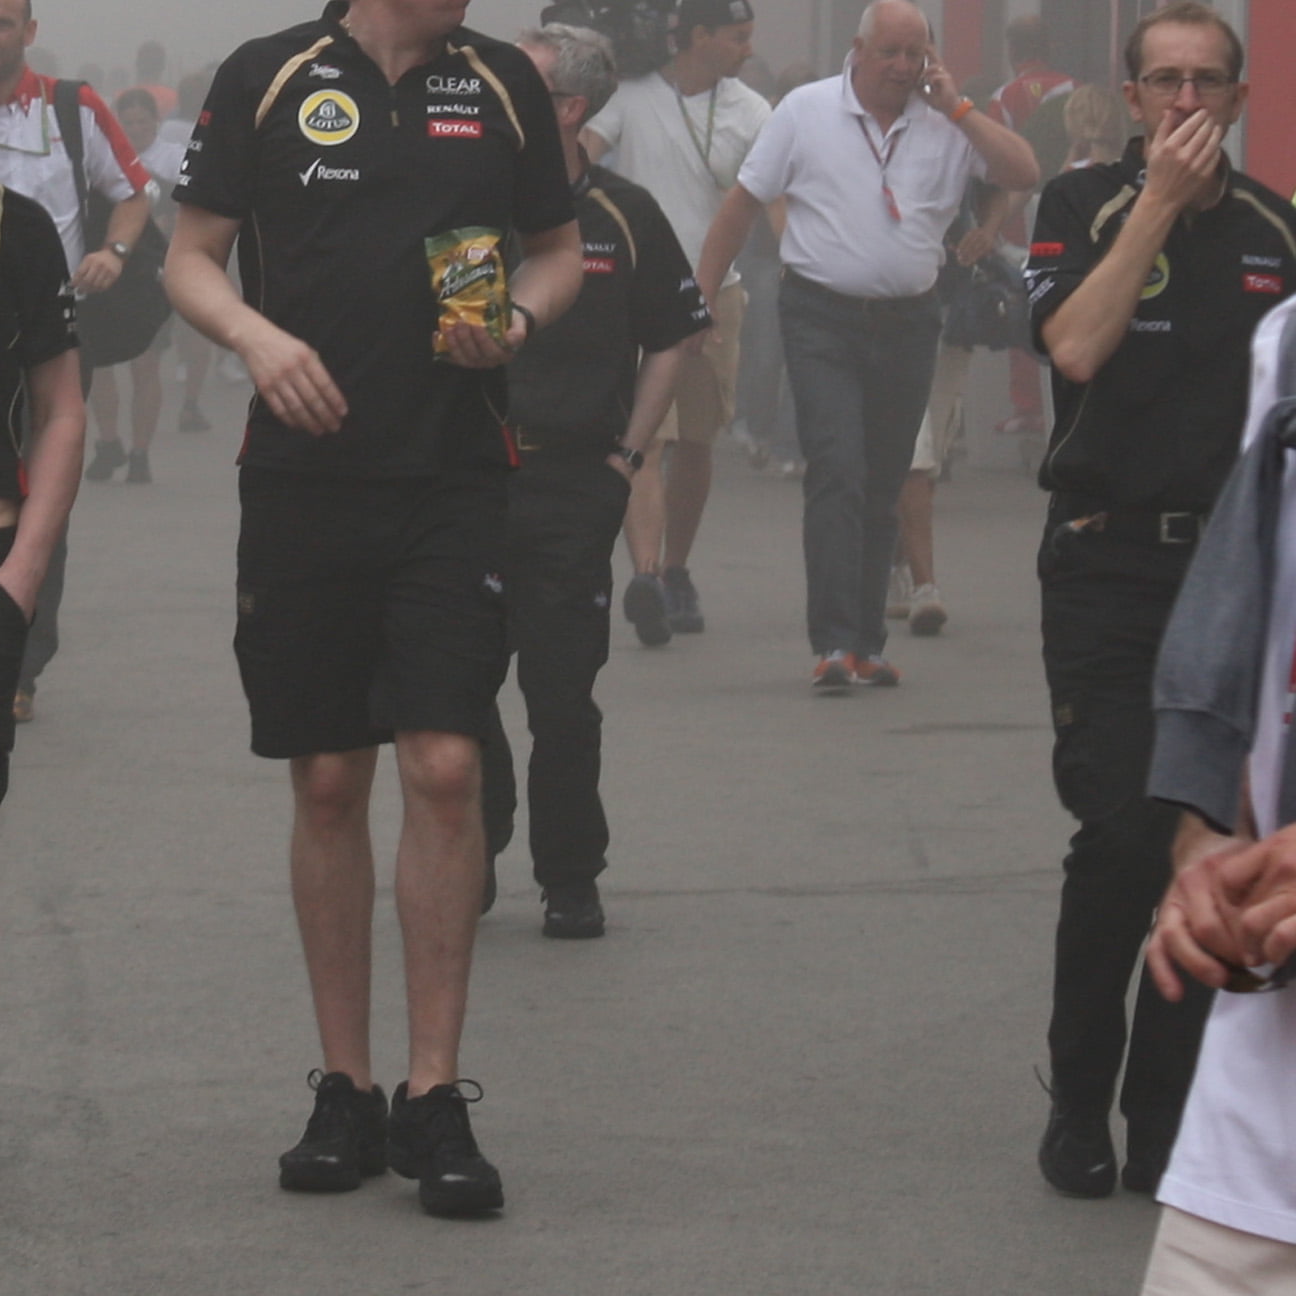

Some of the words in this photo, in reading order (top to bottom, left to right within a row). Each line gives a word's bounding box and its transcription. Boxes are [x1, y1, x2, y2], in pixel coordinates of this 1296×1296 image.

[426, 75, 480, 93] CLEAR
[427, 104, 479, 114] RENAULT
[308, 117, 350, 129] LOTUS
[432, 122, 478, 134] TOTAL
[317, 165, 359, 180] Rexona
[582, 261, 614, 272] OTAL
